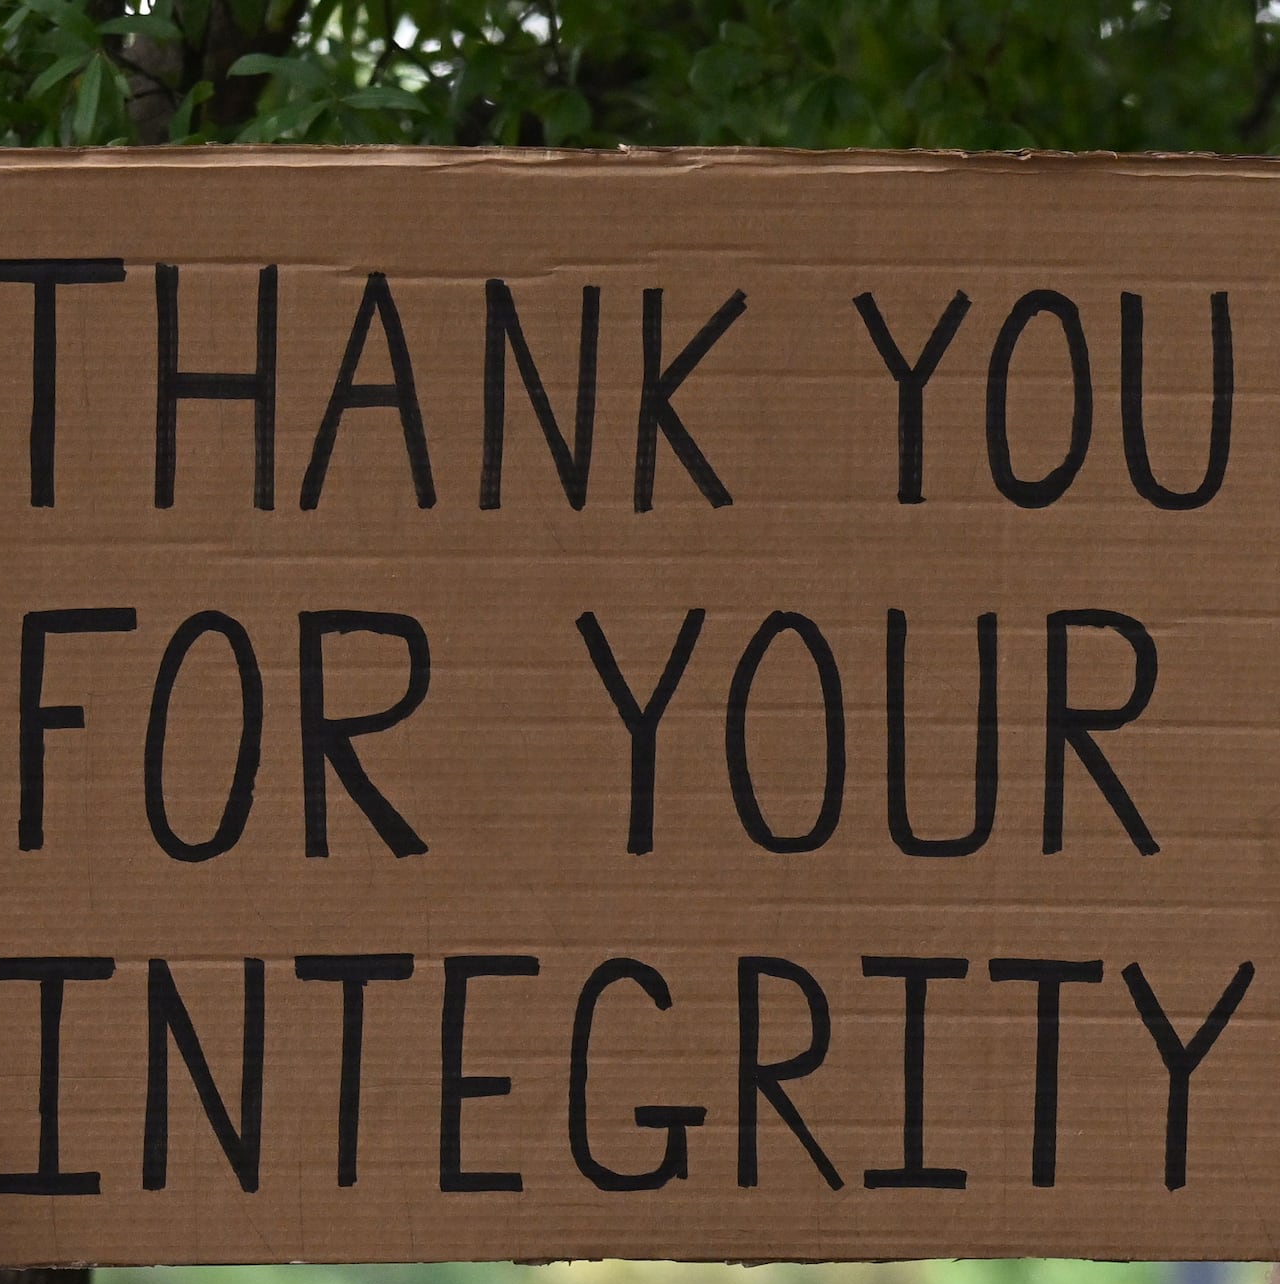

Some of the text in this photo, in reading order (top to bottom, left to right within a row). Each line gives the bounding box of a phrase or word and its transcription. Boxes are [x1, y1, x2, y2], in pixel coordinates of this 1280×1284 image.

[852, 288, 1234, 512] YOU
[17, 607, 1160, 863] FOR YOUR
